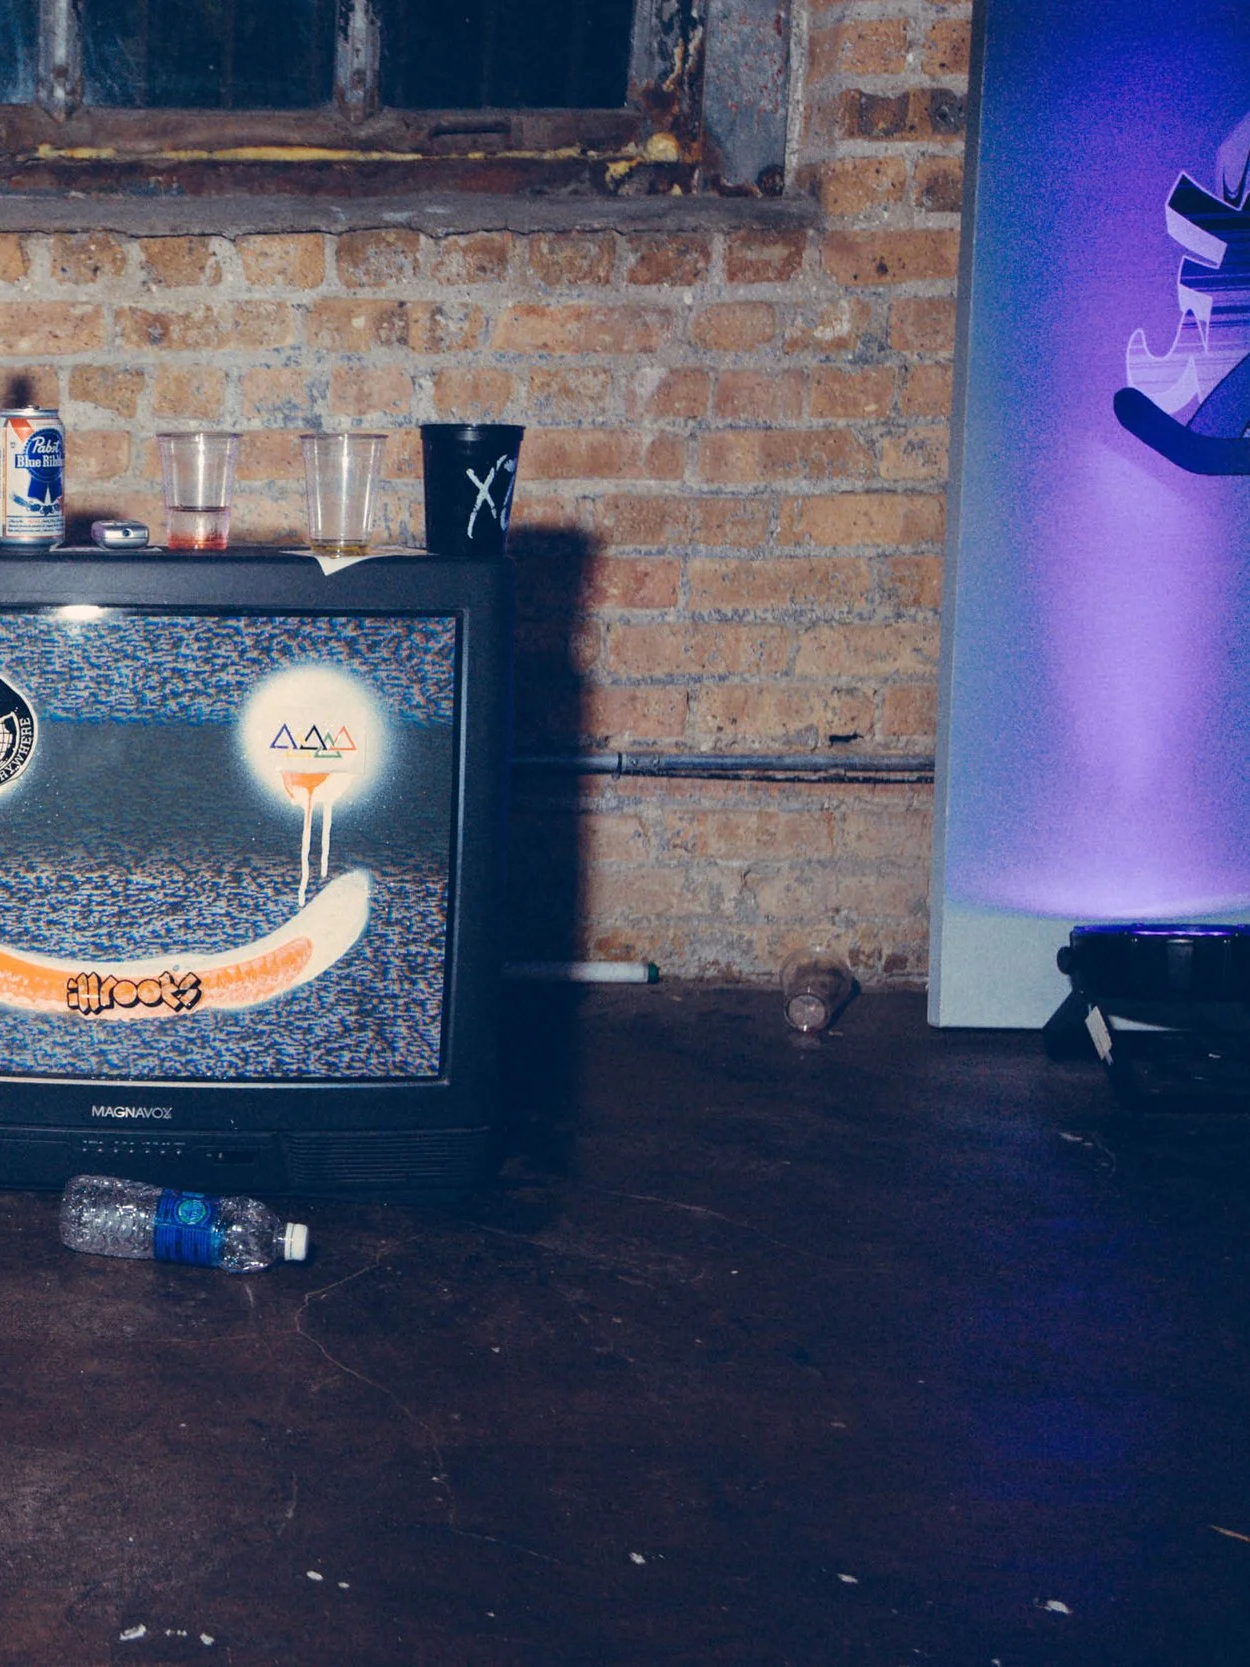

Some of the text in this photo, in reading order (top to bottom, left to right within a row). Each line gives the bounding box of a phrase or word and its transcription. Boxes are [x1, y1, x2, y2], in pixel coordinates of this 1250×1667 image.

[31, 436, 60, 454] Pabst
[16, 455, 41, 468] Blue
[67, 971, 202, 1016] illroots
[91, 1105, 173, 1120] MAGNAVOX
